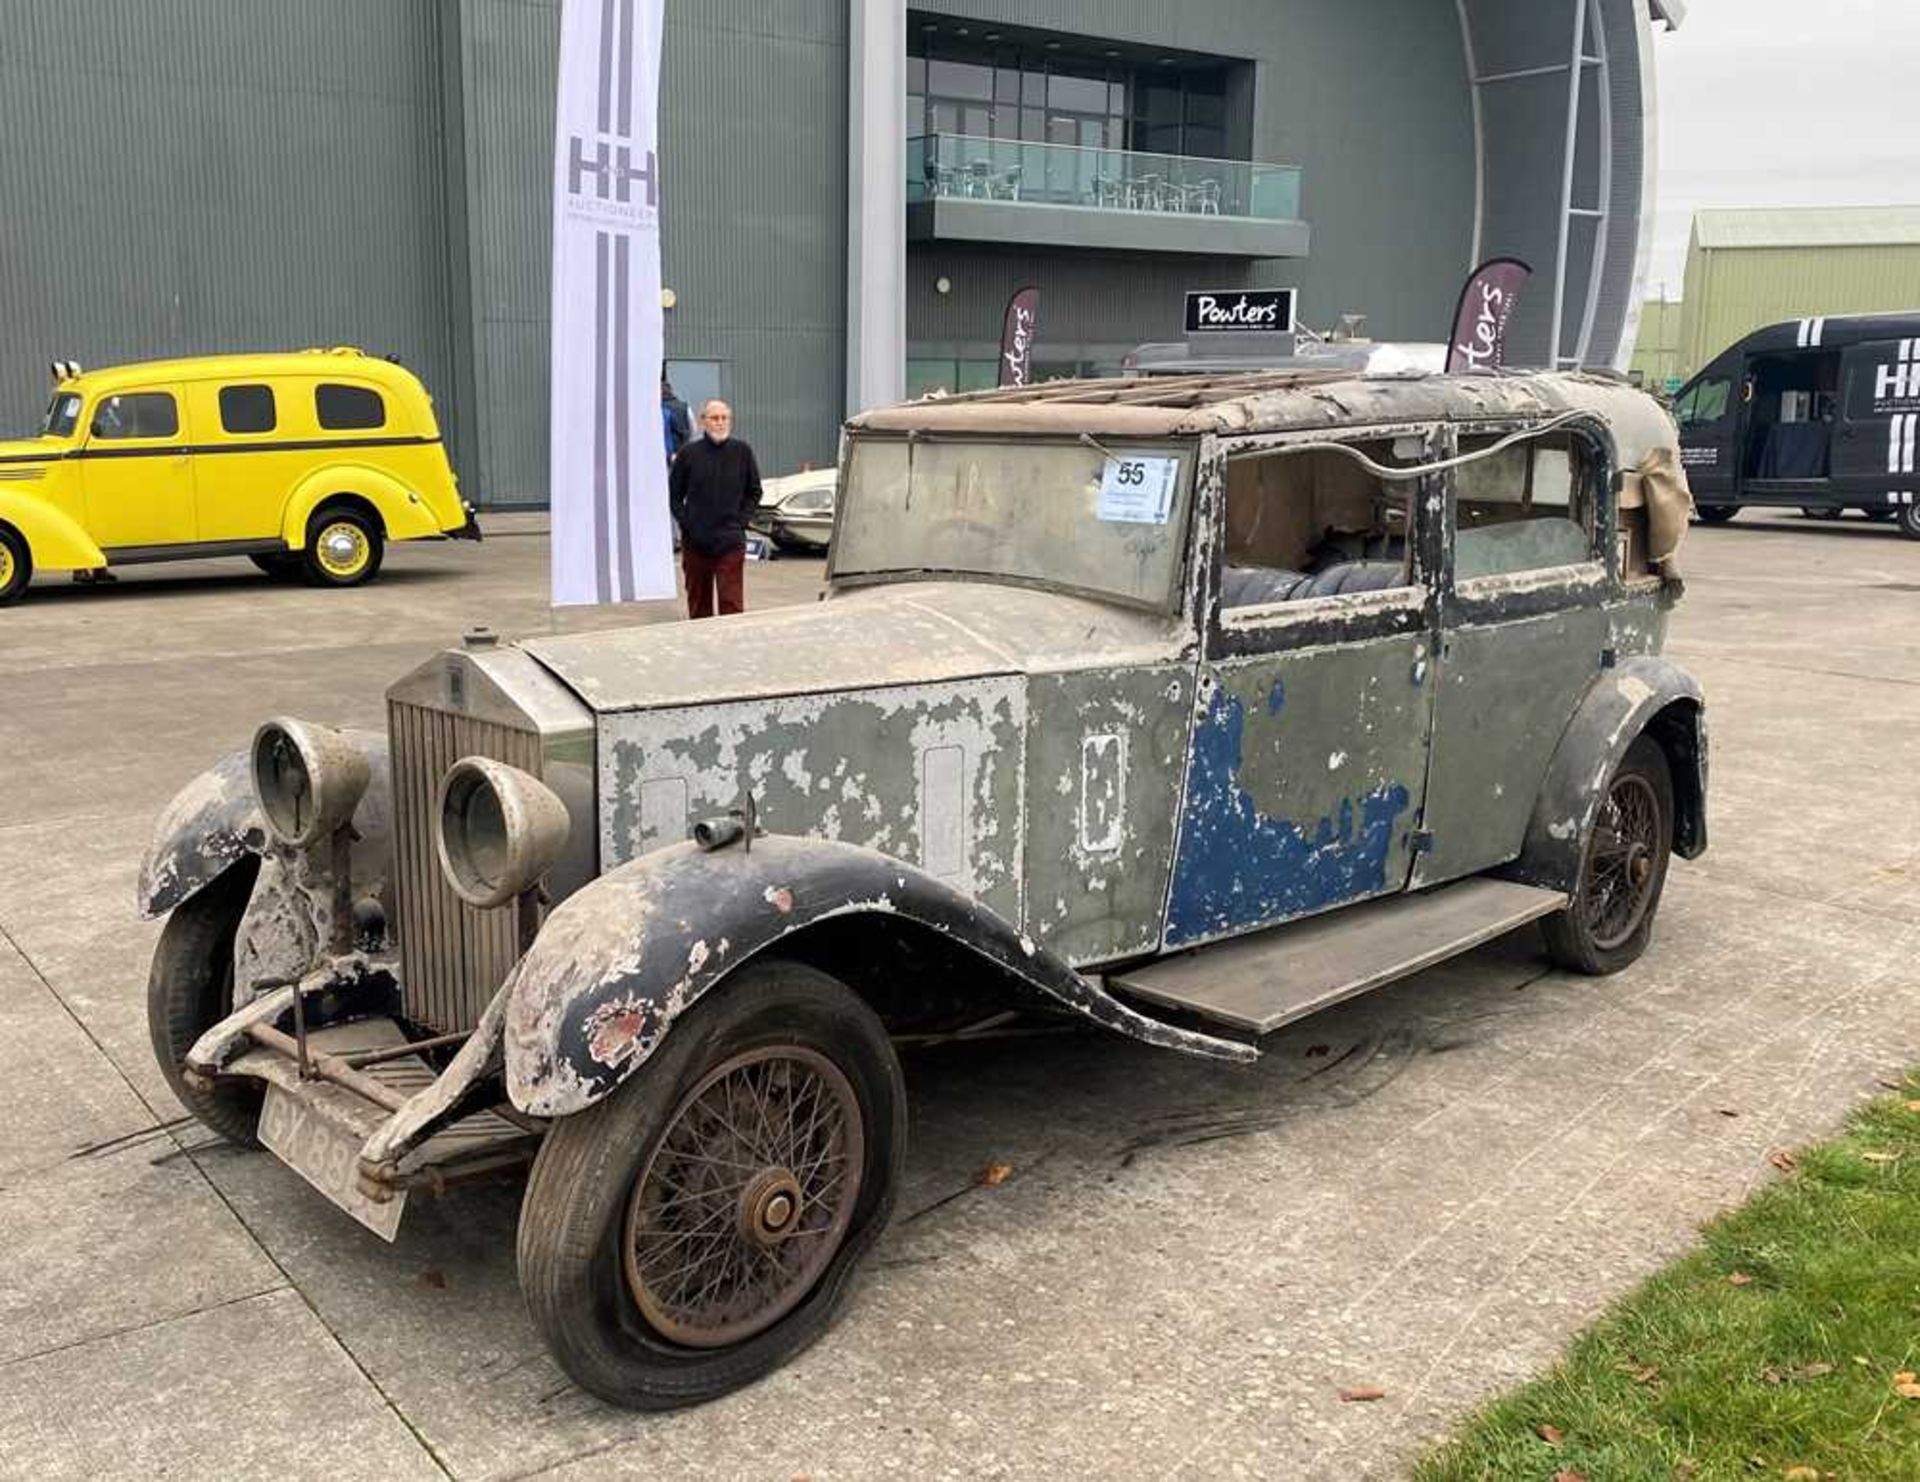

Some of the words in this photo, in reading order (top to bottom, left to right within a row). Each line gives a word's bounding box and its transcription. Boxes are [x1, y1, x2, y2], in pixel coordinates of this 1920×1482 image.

[1198, 294, 1279, 323] Powters'
[1458, 280, 1503, 368] ters'
[1118, 462, 1146, 486] 55
